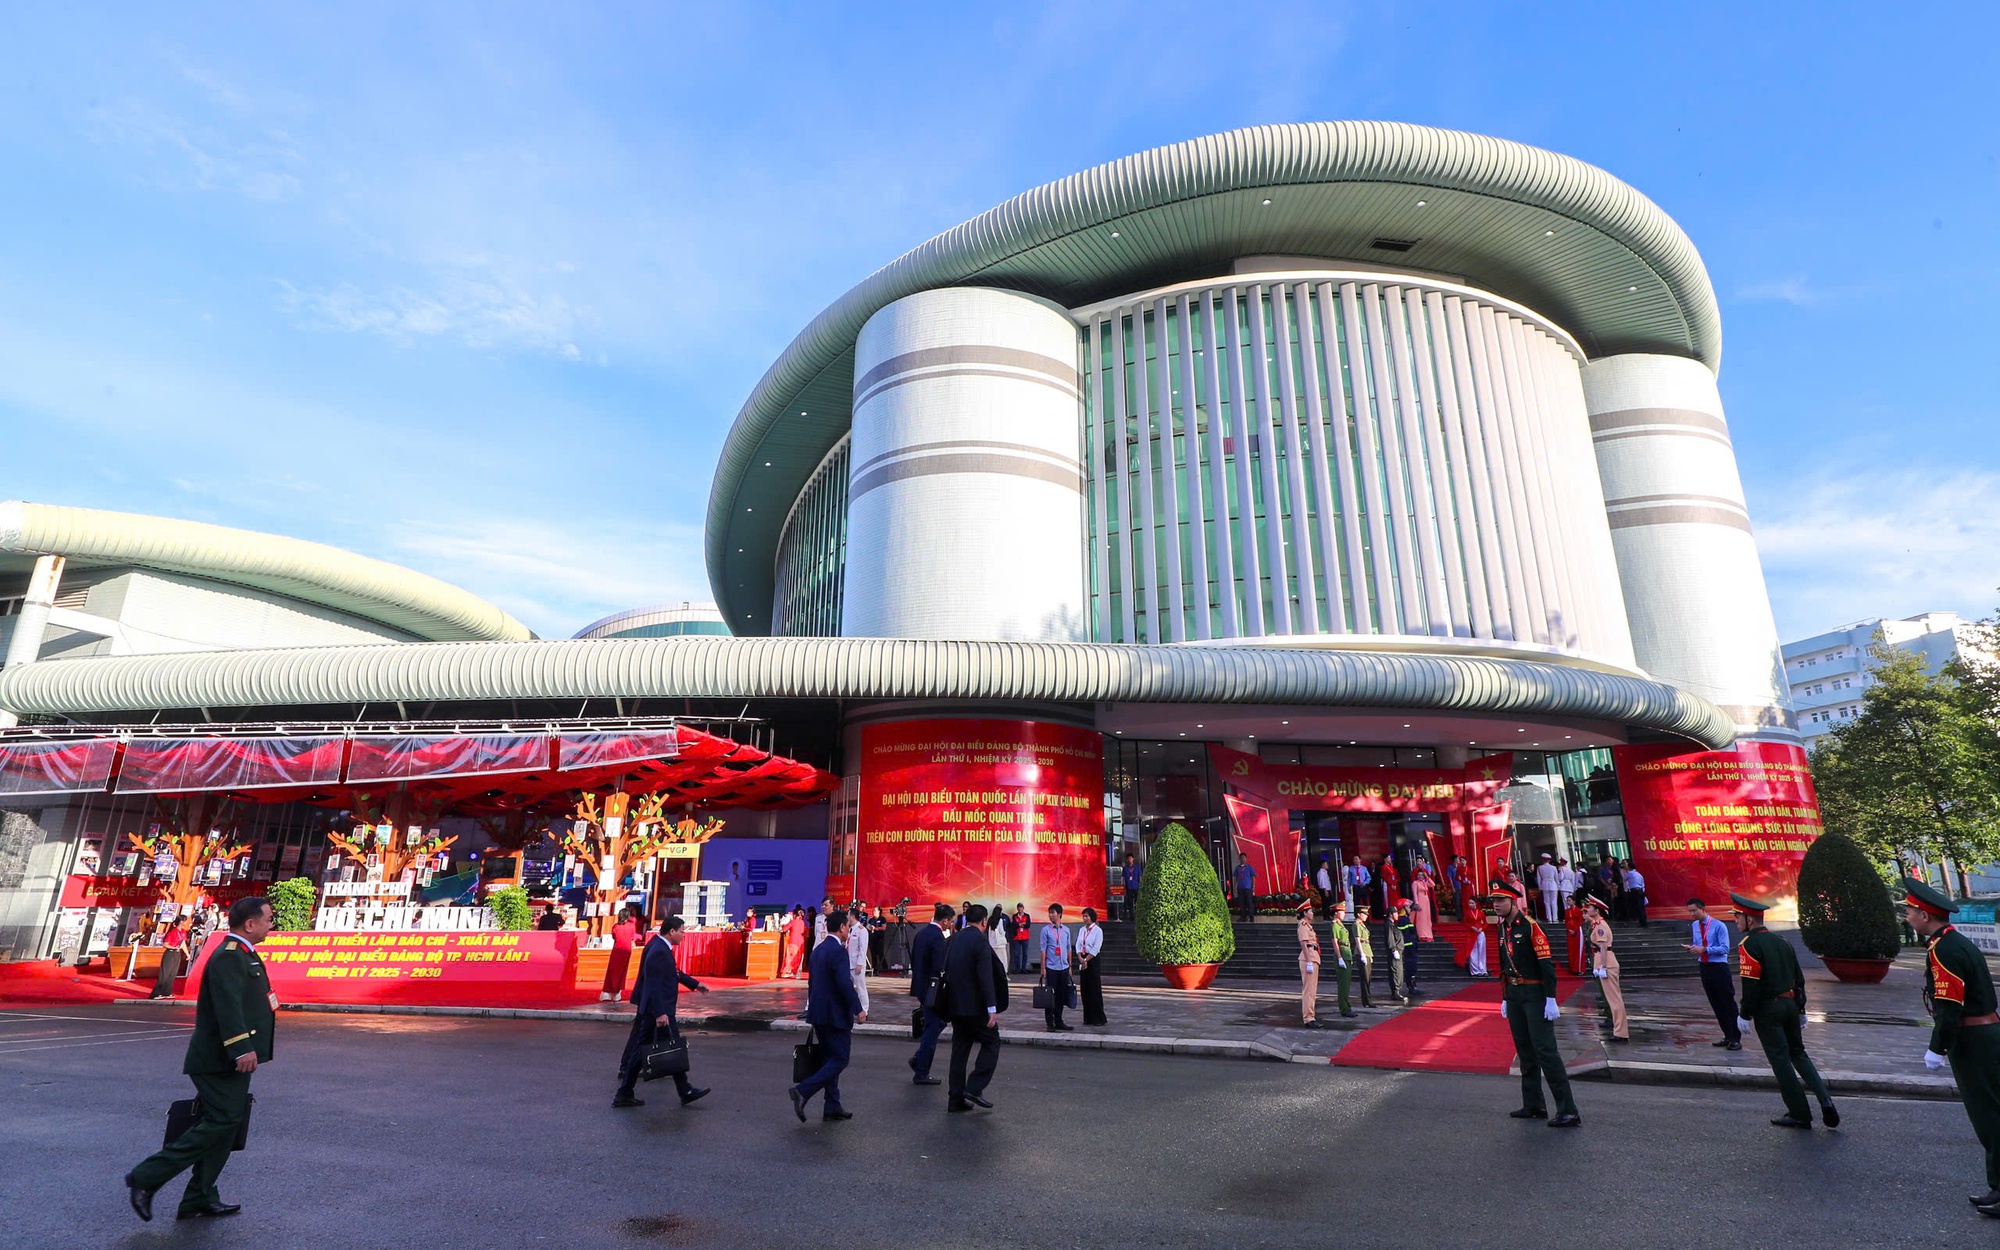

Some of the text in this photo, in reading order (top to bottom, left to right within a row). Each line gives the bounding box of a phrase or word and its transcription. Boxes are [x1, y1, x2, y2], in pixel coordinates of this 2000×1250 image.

[918, 742, 932, 752] ĐẠI
[933, 740, 949, 752] HỘI
[950, 742, 965, 752] ĐẠI
[931, 752, 947, 763] LẦN
[949, 753, 965, 763] THỨ
[974, 753, 1000, 765] NHIỆM
[1037, 758, 1054, 766] 2030
[1635, 761, 1660, 772] CHÀO
[1689, 762, 1705, 771] ĐẠI
[1706, 760, 1722, 771] HỘI
[1723, 761, 1738, 771] ĐẠI
[1277, 776, 1455, 802] CHÀO MỪNG ĐẠI BIỂU
[882, 793, 896, 808] ĐẠI
[897, 790, 911, 807] HỘI
[913, 792, 928, 806] ĐẠI
[930, 787, 952, 804] BIỂU
[954, 789, 979, 804] TOÀN
[981, 788, 1007, 805] QUỐC
[1009, 789, 1027, 805] LẦN
[1060, 792, 1073, 808] CỦA
[942, 806, 962, 823] DẤU
[964, 806, 986, 823] MỐC
[989, 811, 1014, 823] QUAN
[1694, 803, 1721, 817] TOÀN
[1752, 803, 1776, 817] TOÀN
[1674, 819, 1703, 834] ĐỒNG
[1704, 820, 1731, 834] LÒNG
[1732, 822, 1764, 834] CHUNG
[1765, 821, 1783, 834] SỨC
[866, 829, 884, 843] TRÊN
[886, 830, 903, 842] CON
[904, 827, 935, 842] ĐƯỜNG
[937, 827, 962, 842] PHÁT
[964, 825, 992, 842] TRIỂN
[994, 826, 1013, 842] CỦA
[1034, 829, 1056, 843] NƯỚC
[1057, 830, 1067, 844] VÀ
[669, 846, 688, 854] VGP
[1643, 835, 1657, 851] TỔ
[1658, 836, 1687, 851] QUỐC
[1688, 837, 1709, 853] VIỆT
[1711, 839, 1736, 851] NAM
[1751, 837, 1768, 853] HỘI
[1768, 836, 1786, 851] CHỦ
[299, 935, 330, 946] GIAN
[332, 932, 367, 946] TRIỂN
[397, 934, 424, 946] BÁO
[425, 933, 449, 946] CHÍ
[456, 932, 491, 946] XUẤT
[491, 933, 519, 946] BẢN
[270, 951, 288, 963] VỤ
[288, 951, 310, 963] ĐẠI
[311, 949, 334, 963] HỘI
[334, 951, 357, 963] ĐẠI
[357, 947, 388, 962] BIỂU
[388, 949, 424, 962] ĐẢNG
[425, 949, 444, 964] BỘ
[464, 951, 495, 962] HCM
[496, 948, 523, 962] LẦN
[306, 965, 349, 979] NHIỆM
[349, 965, 368, 977] KỲ
[368, 967, 400, 977] 2025
[410, 967, 443, 978] 2030
